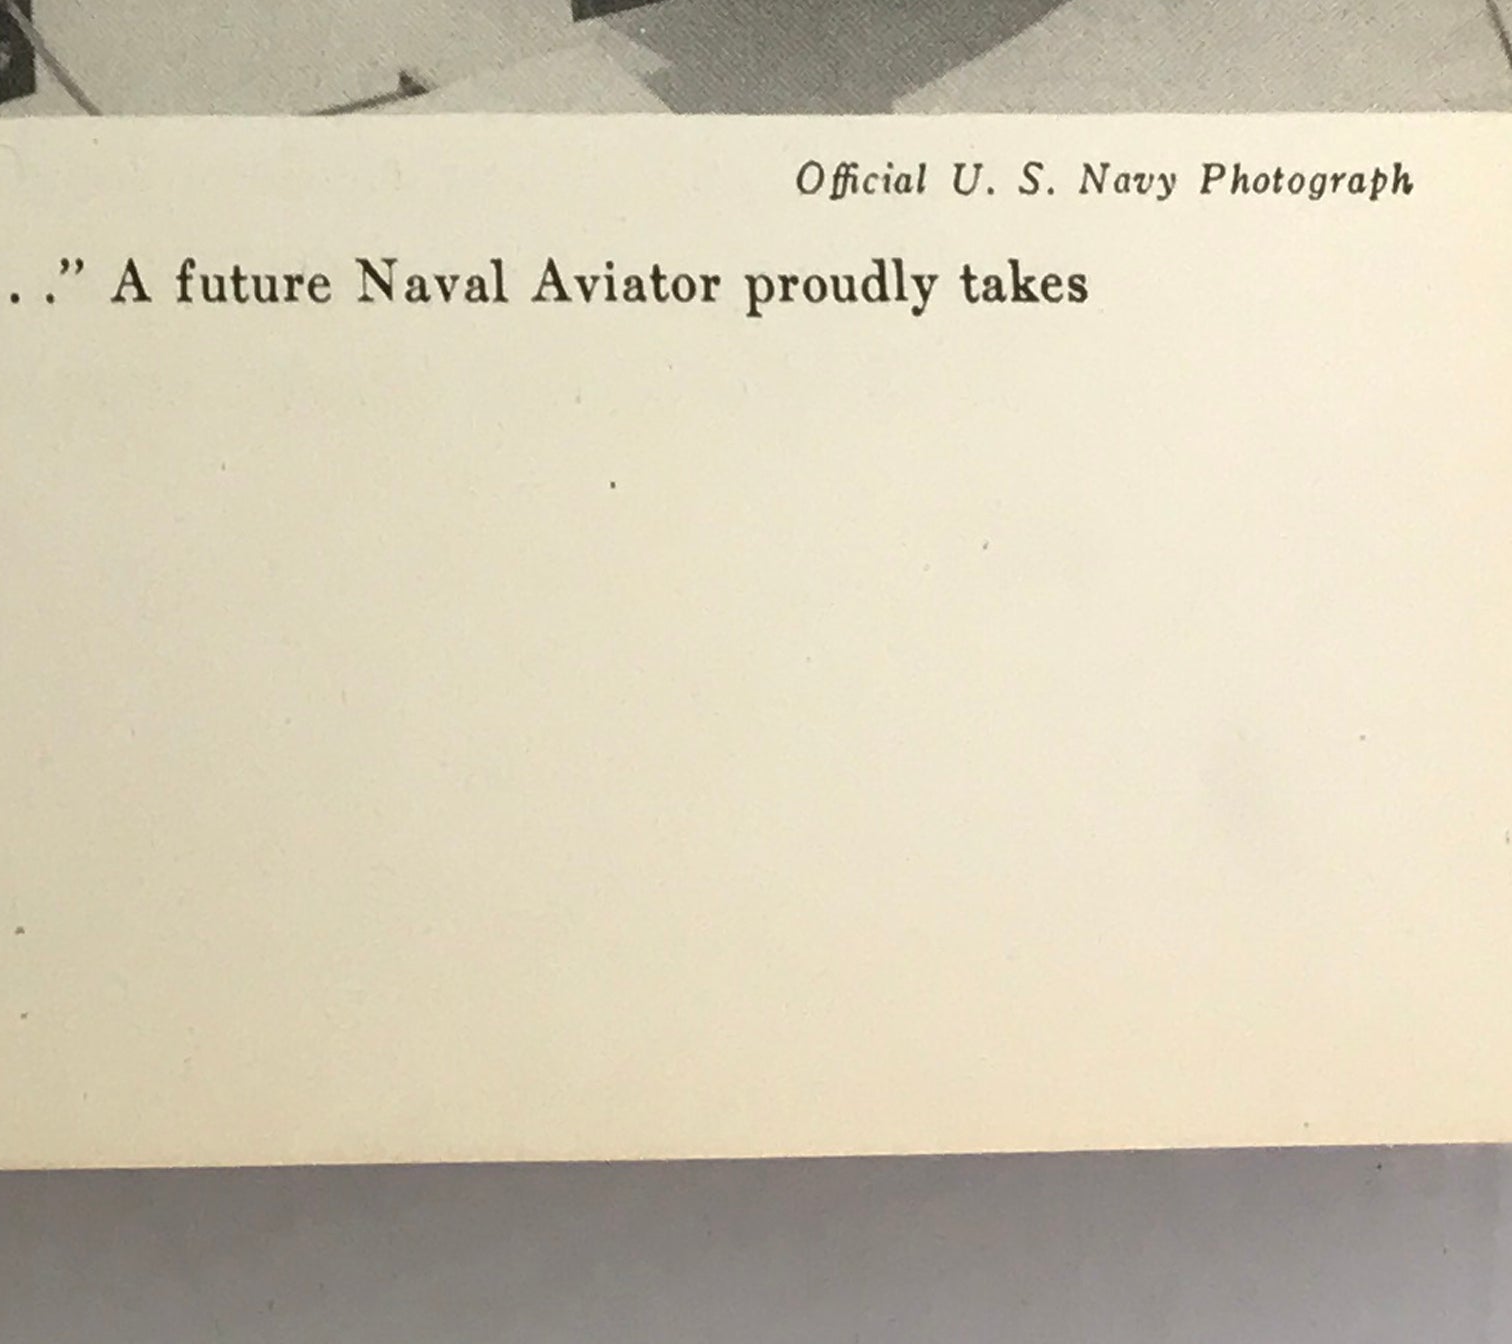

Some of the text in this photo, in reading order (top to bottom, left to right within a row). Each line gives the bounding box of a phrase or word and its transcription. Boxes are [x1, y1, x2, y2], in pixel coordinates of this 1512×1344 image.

[794, 158, 1416, 204] Official U. S. Navy Photograph
[108, 256, 154, 306] A
[174, 255, 333, 306] future
[353, 256, 511, 305] Naval
[529, 255, 723, 305] Aviator
[742, 255, 941, 320] proudly
[957, 256, 1090, 306] takes
